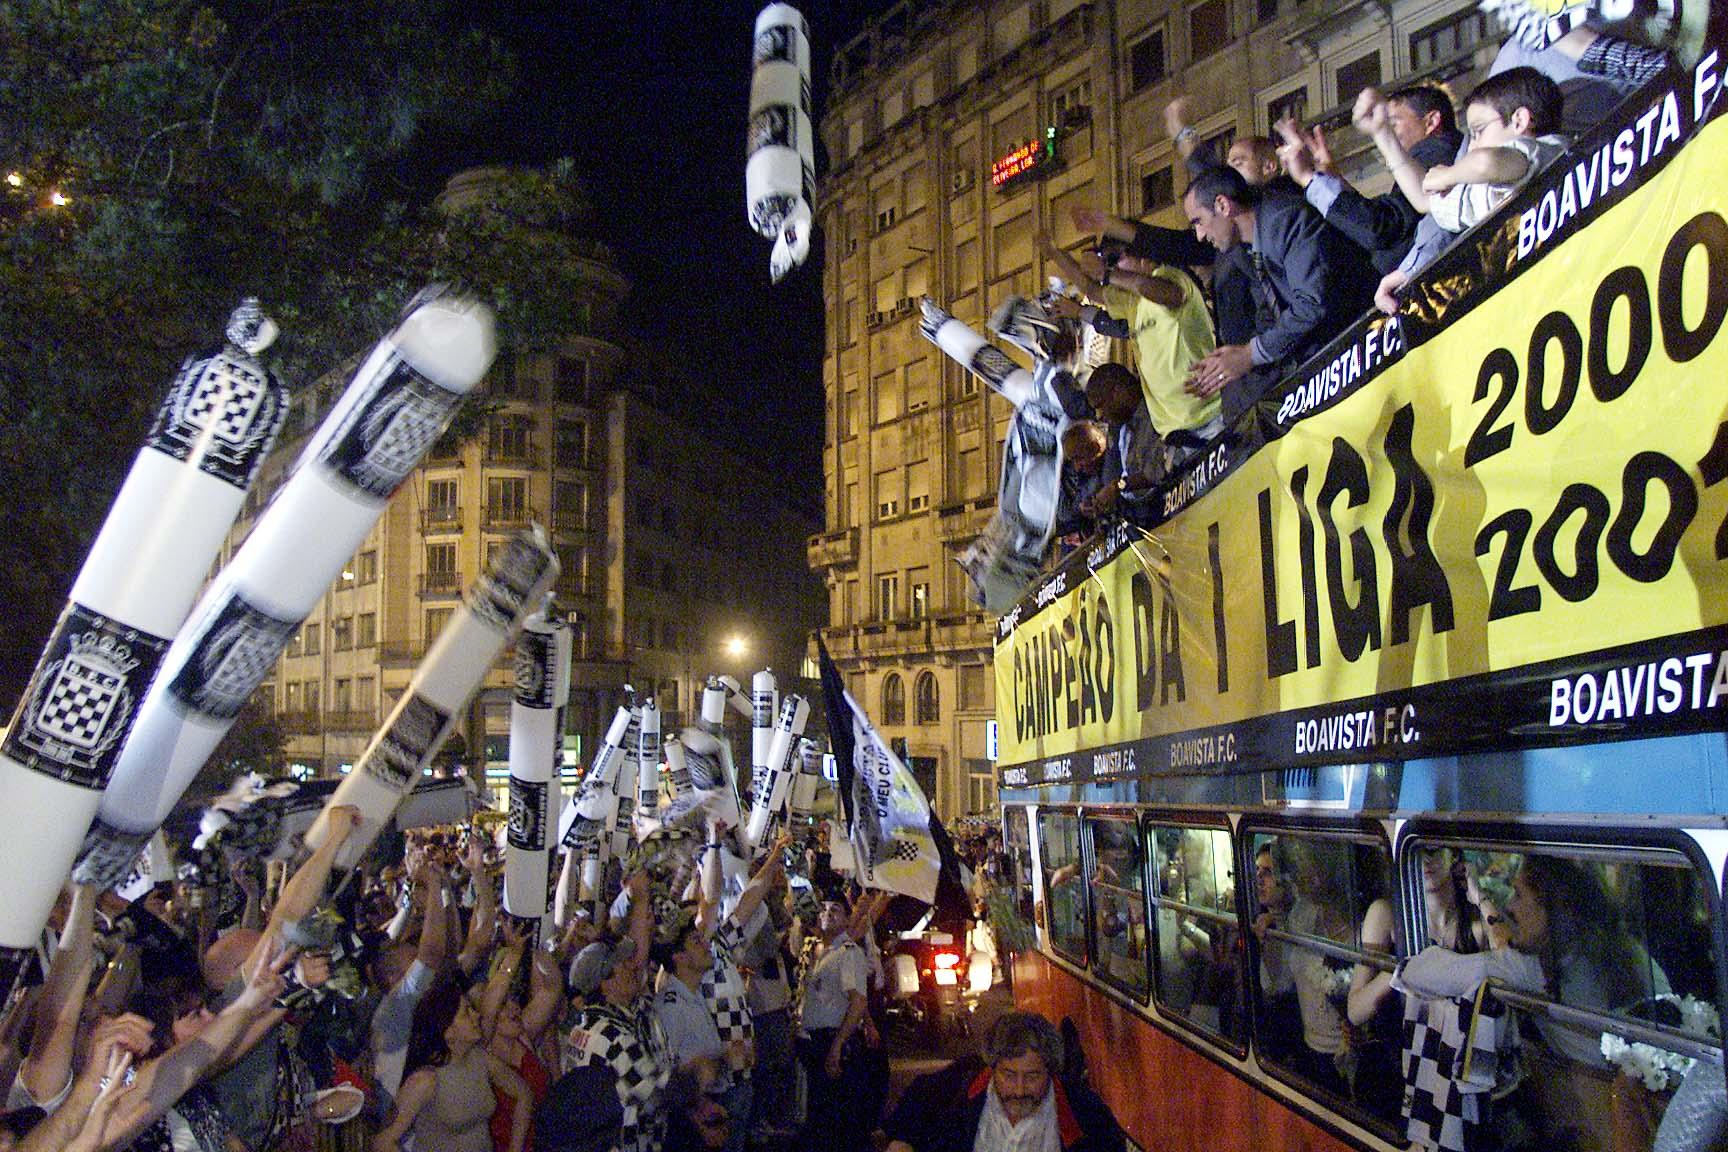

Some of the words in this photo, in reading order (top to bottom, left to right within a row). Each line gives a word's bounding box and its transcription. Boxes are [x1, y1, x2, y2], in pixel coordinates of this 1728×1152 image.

[1517, 91, 1681, 260] BOAVISTA
[1277, 344, 1361, 425] BOAVISTA
[1365, 317, 1401, 370] F.C.
[1464, 211, 1728, 469] 2000
[1163, 461, 1206, 517] BOAVISTA
[1208, 443, 1228, 481] F.C.
[1013, 585, 1115, 744] CAMPEÃO
[1132, 569, 1186, 713] DA
[1208, 521, 1229, 694] I
[1257, 403, 1455, 679] LIGA
[1549, 650, 1728, 726] BOAVISTA
[878, 746, 890, 775] CLU
[1093, 751, 1121, 776] BOAVISTA
[1122, 748, 1136, 772] F.C.
[1170, 736, 1215, 767] BOAVISTA
[1217, 733, 1237, 762] F.C.
[1295, 710, 1376, 754] BOAVISTA
[1384, 703, 1420, 744] F.C.
[878, 780, 890, 807] MEU
